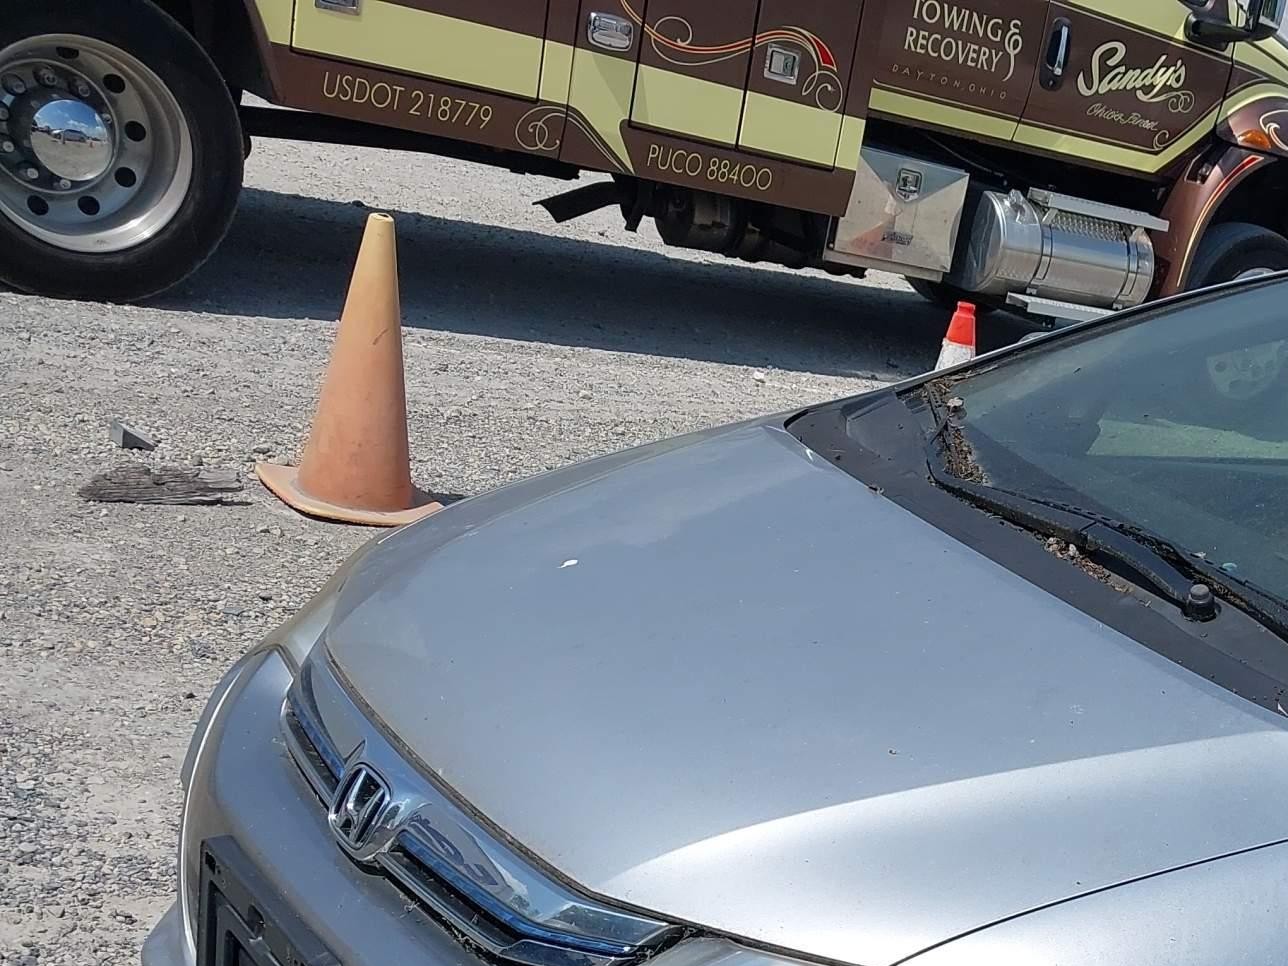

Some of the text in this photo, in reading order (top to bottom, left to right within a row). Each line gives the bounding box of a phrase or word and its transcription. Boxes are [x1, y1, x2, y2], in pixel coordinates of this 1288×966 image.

[904, 26, 1003, 73] RECOVERY
[913, 0, 1023, 82] TOWING &
[968, 83, 1007, 100] OHIO
[1077, 41, 1187, 103] Sandy's
[323, 71, 493, 130] USDOT 218779
[647, 144, 773, 191] PUCO 88400
